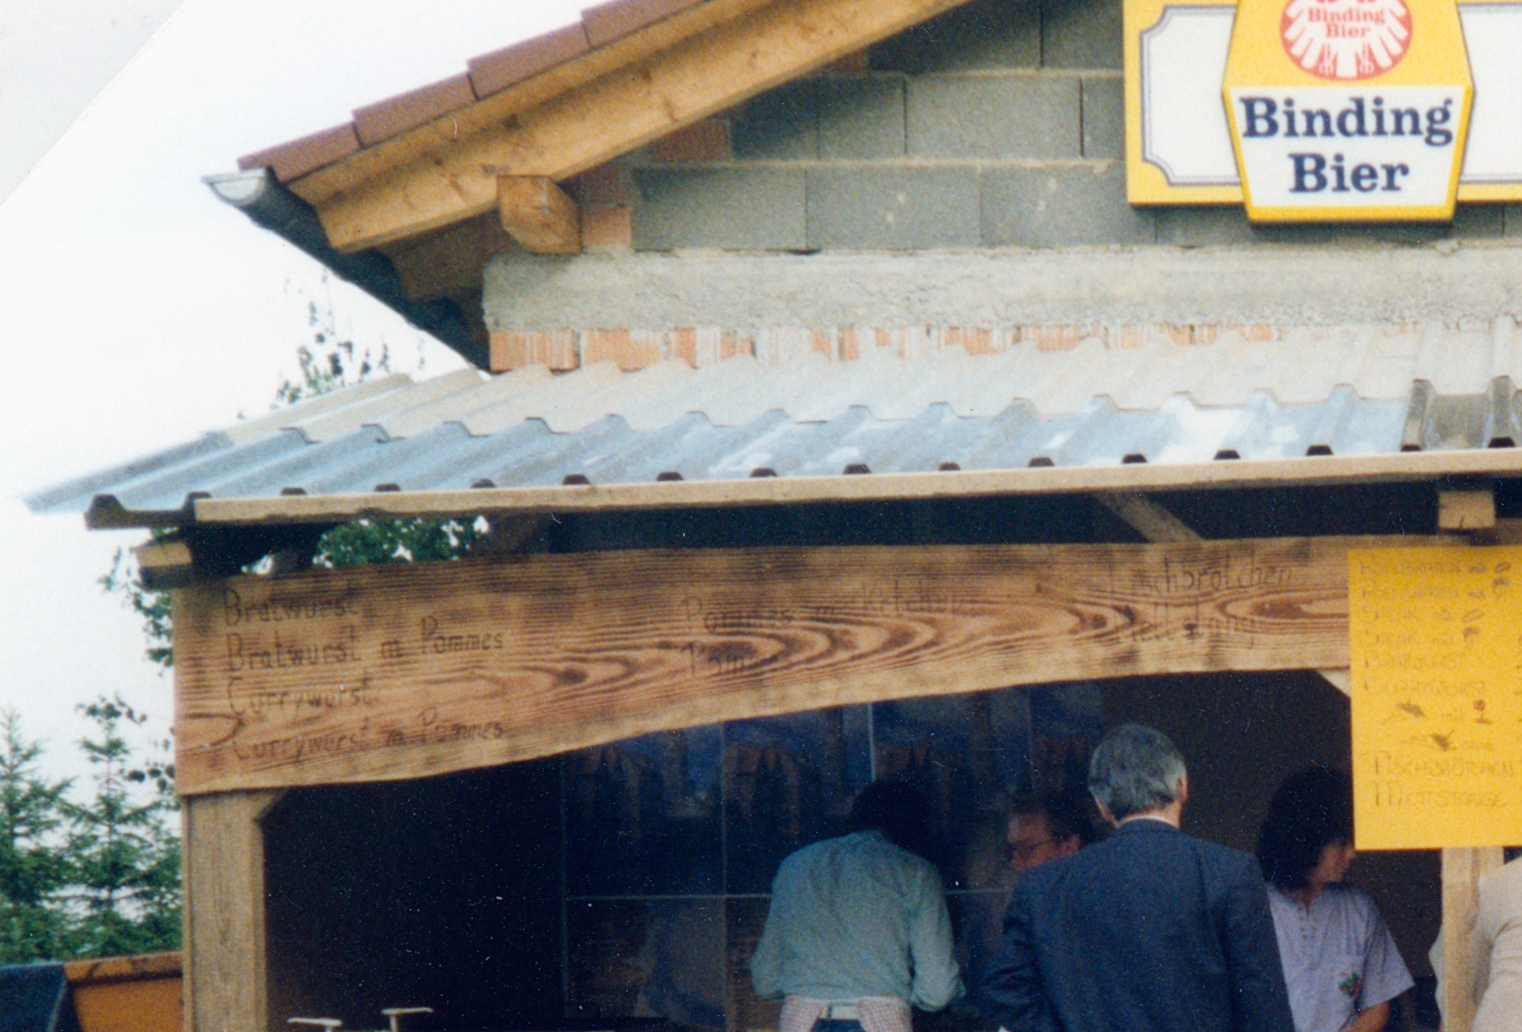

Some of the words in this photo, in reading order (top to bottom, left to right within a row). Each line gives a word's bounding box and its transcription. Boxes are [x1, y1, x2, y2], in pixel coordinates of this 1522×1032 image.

[1308, 7, 1386, 24] Binding
[1326, 24, 1371, 38] Bier
[1239, 96, 1454, 147] Binding
[1287, 152, 1410, 193] Bier
[222, 587, 362, 628] Bratwurst
[224, 626, 363, 673] Bratwurst
[420, 615, 504, 655] Pommes
[227, 669, 378, 716] Currywurst
[232, 717, 372, 762] Currywurst
[417, 706, 505, 745] Pommes
